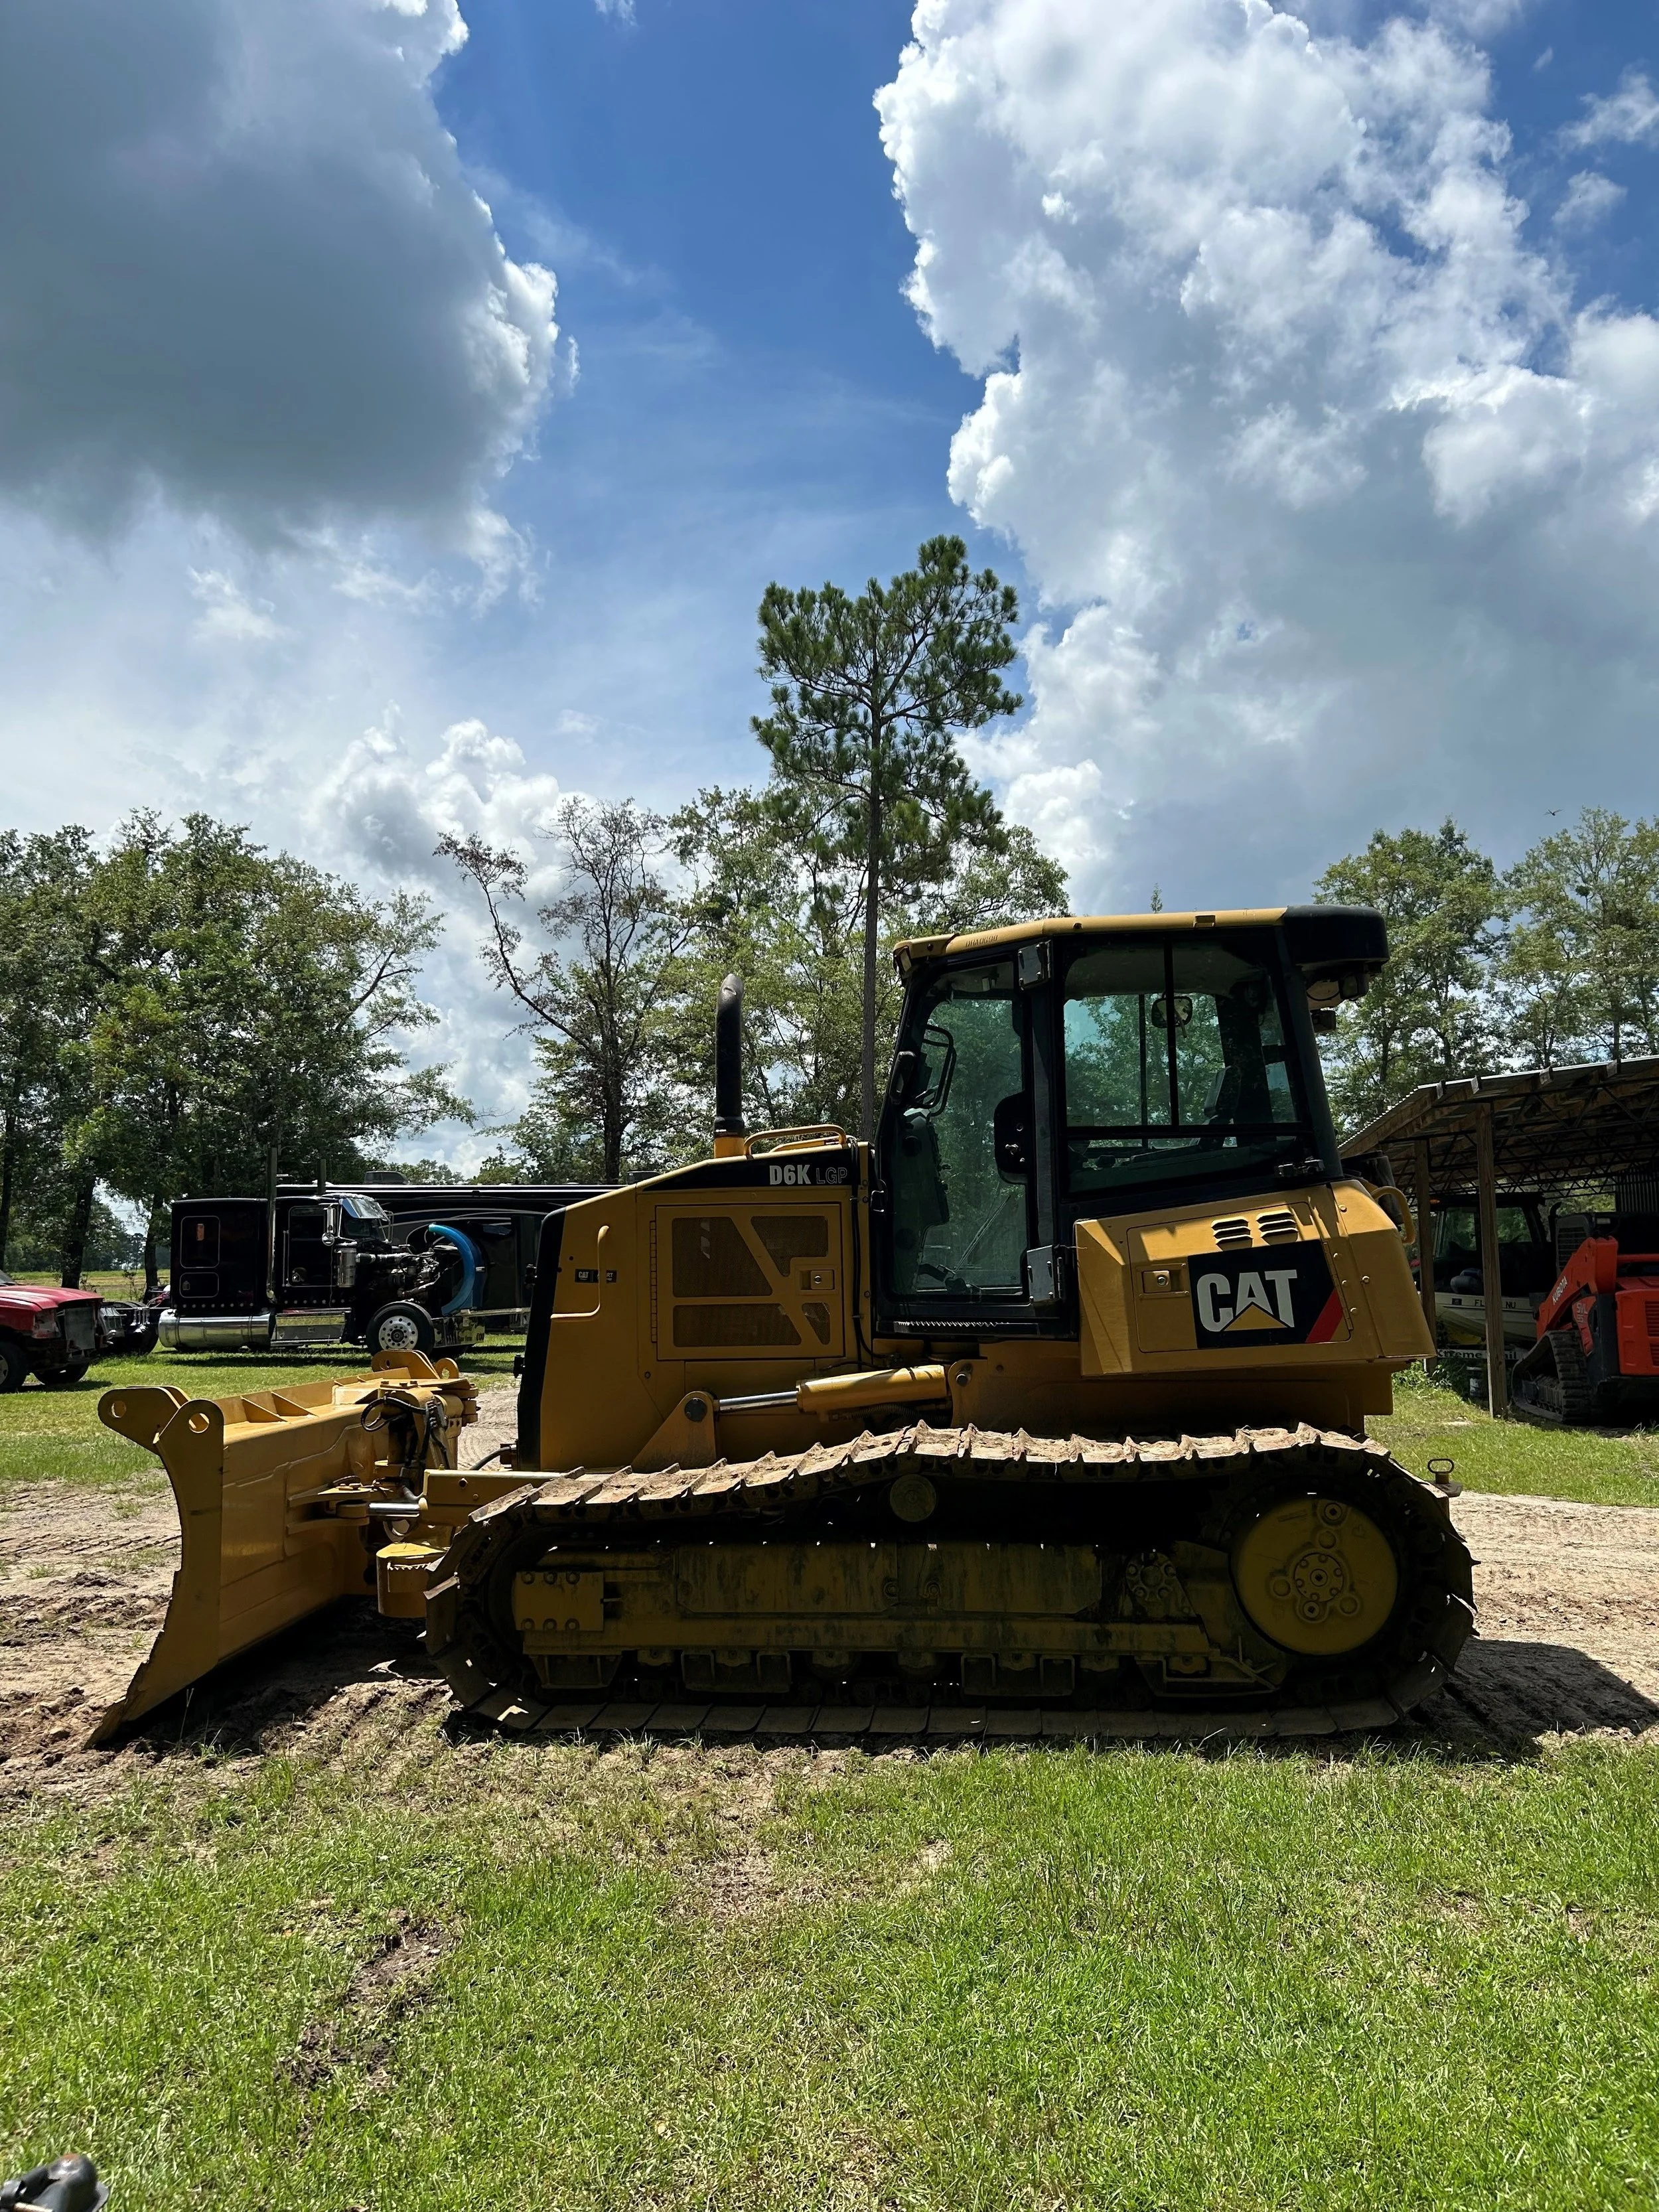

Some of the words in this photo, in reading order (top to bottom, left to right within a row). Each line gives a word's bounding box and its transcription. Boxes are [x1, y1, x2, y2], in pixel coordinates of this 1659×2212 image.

[769, 1165, 811, 1185] D6K
[816, 1167, 847, 1184] LGP
[1196, 1269, 1297, 1332] CAT
[1552, 1276, 1567, 1305] KUBOTA
